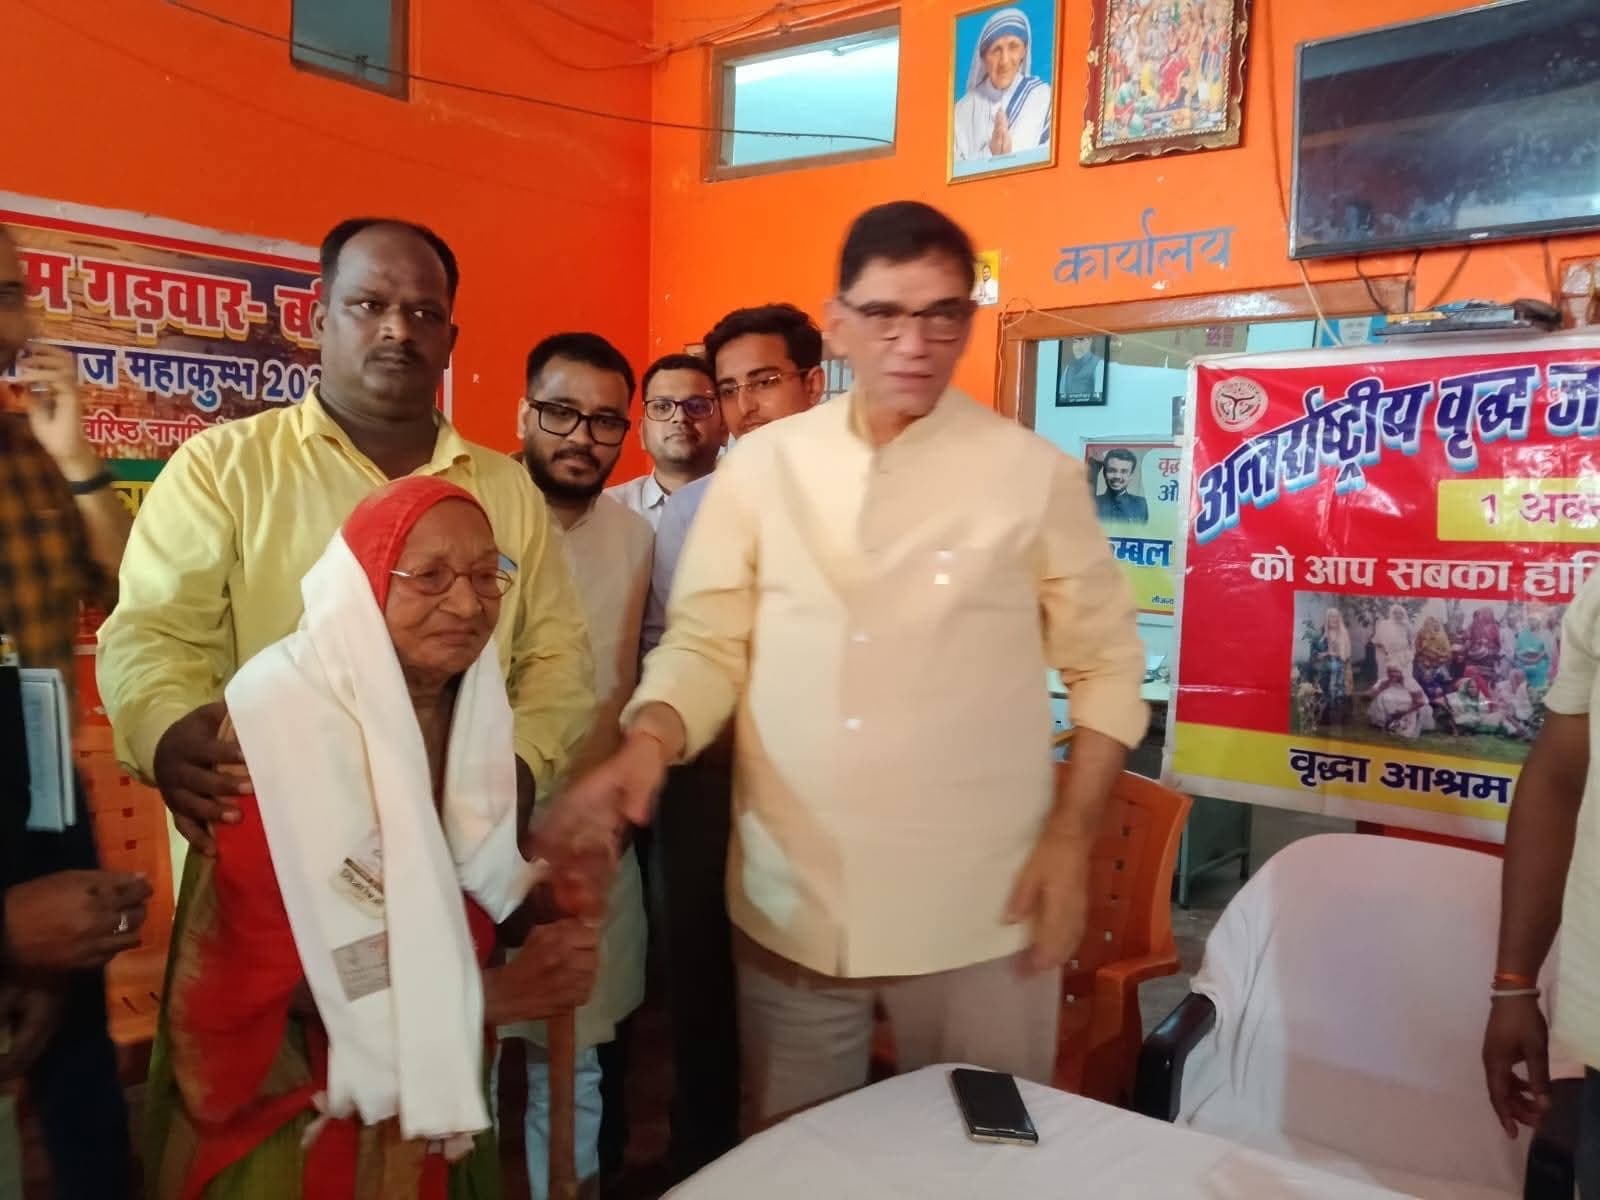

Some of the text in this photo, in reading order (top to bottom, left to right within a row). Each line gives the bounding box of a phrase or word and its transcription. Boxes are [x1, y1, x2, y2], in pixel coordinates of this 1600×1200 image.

[1054, 207, 1237, 284] कार्यालय
[16, 249, 72, 314] म
[124, 349, 256, 409] महाकुम्भ
[1251, 546, 1295, 583] को
[1304, 556, 1378, 587] आप
[1387, 558, 1513, 591] सबका
[1380, 761, 1513, 804] आश्रम
